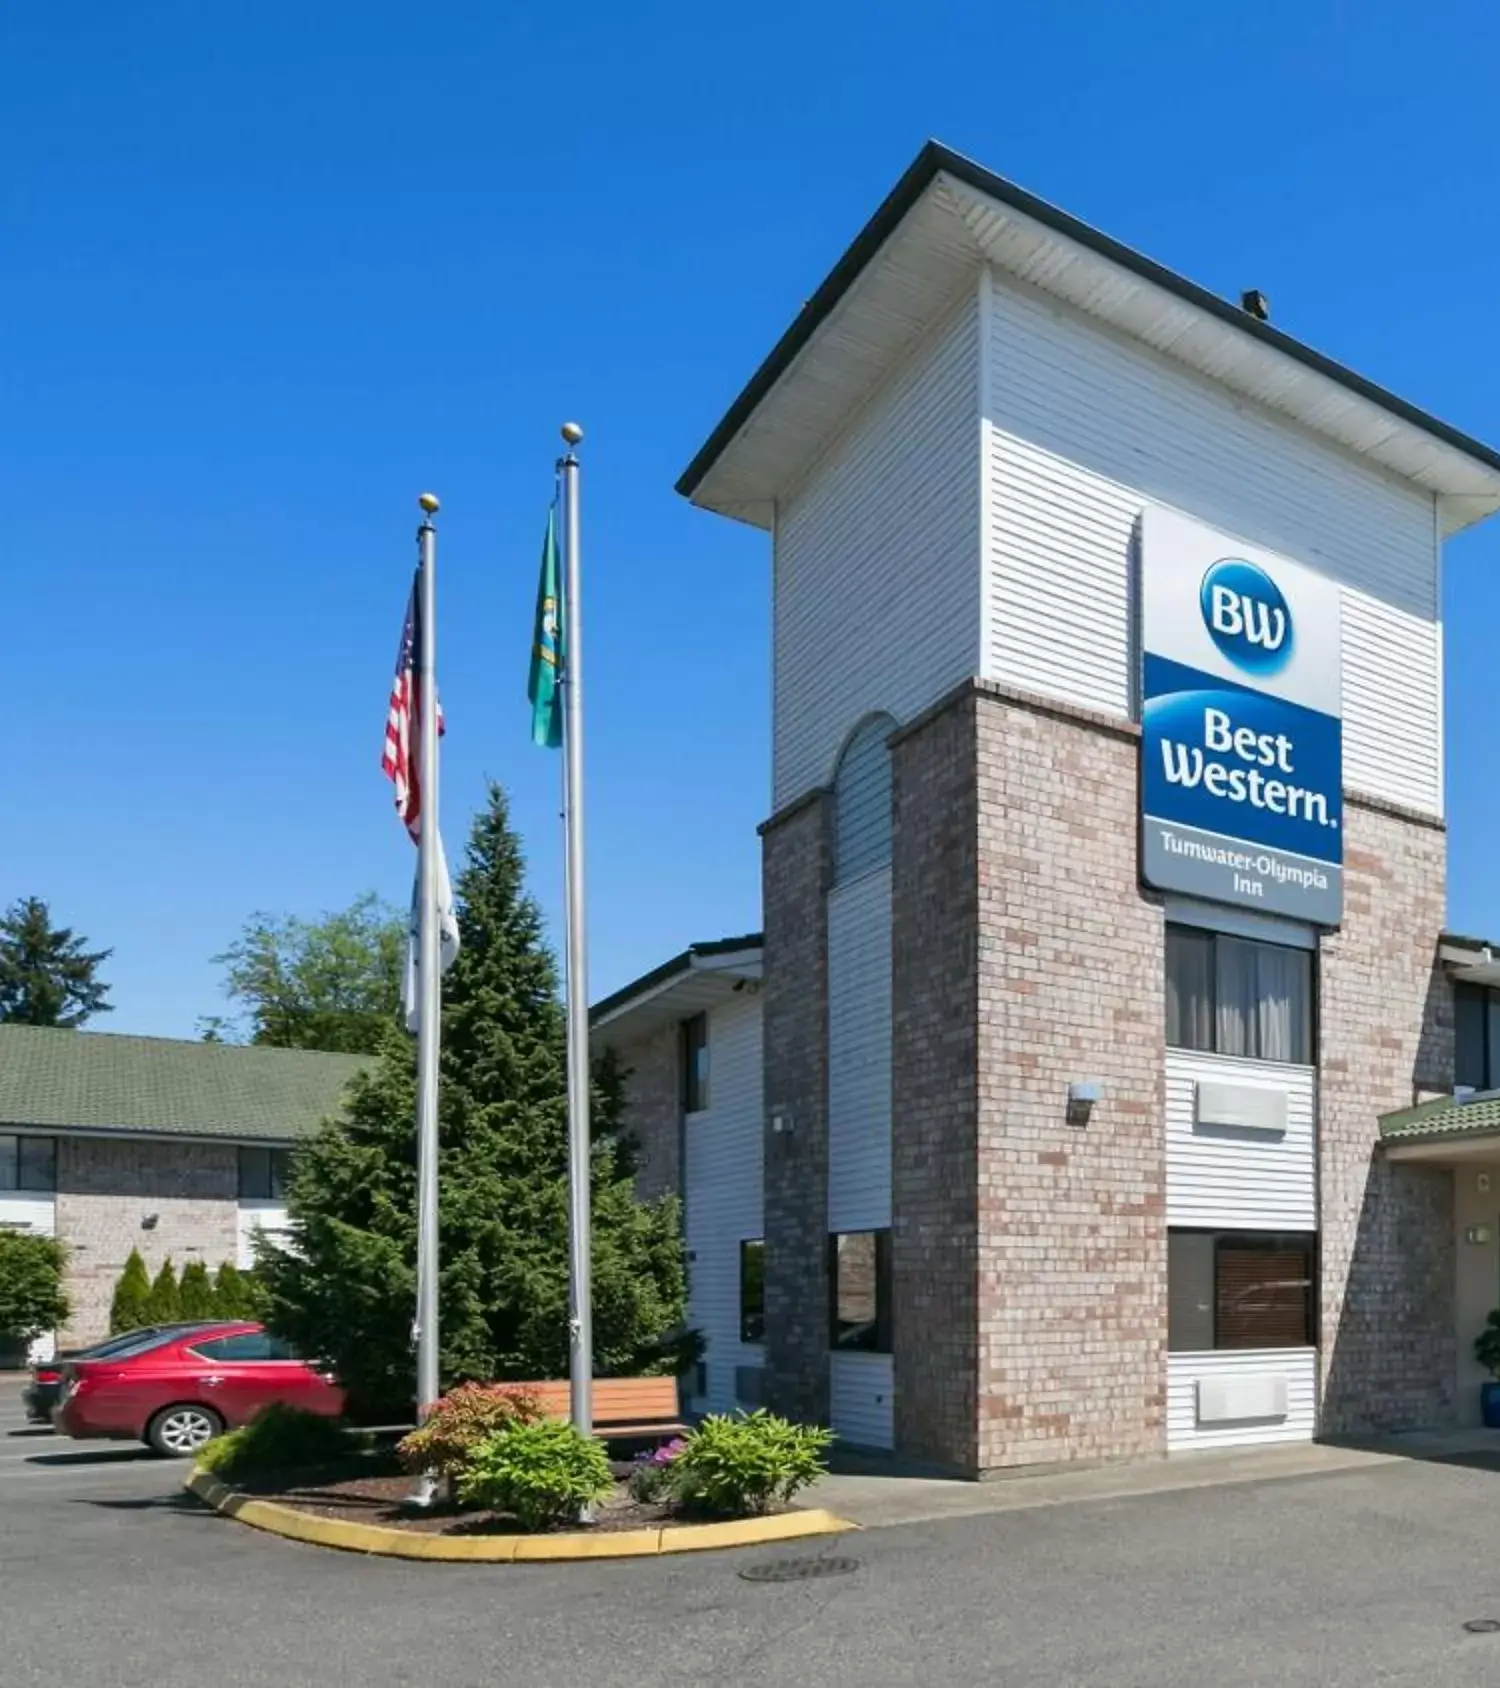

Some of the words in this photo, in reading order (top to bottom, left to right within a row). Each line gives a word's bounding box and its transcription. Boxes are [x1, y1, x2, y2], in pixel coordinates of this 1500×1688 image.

[1212, 585, 1285, 650] BW
[1205, 707, 1294, 773] Best
[1160, 831, 1328, 889] Tumwater-Olympia
[1233, 872, 1264, 897] Inn
